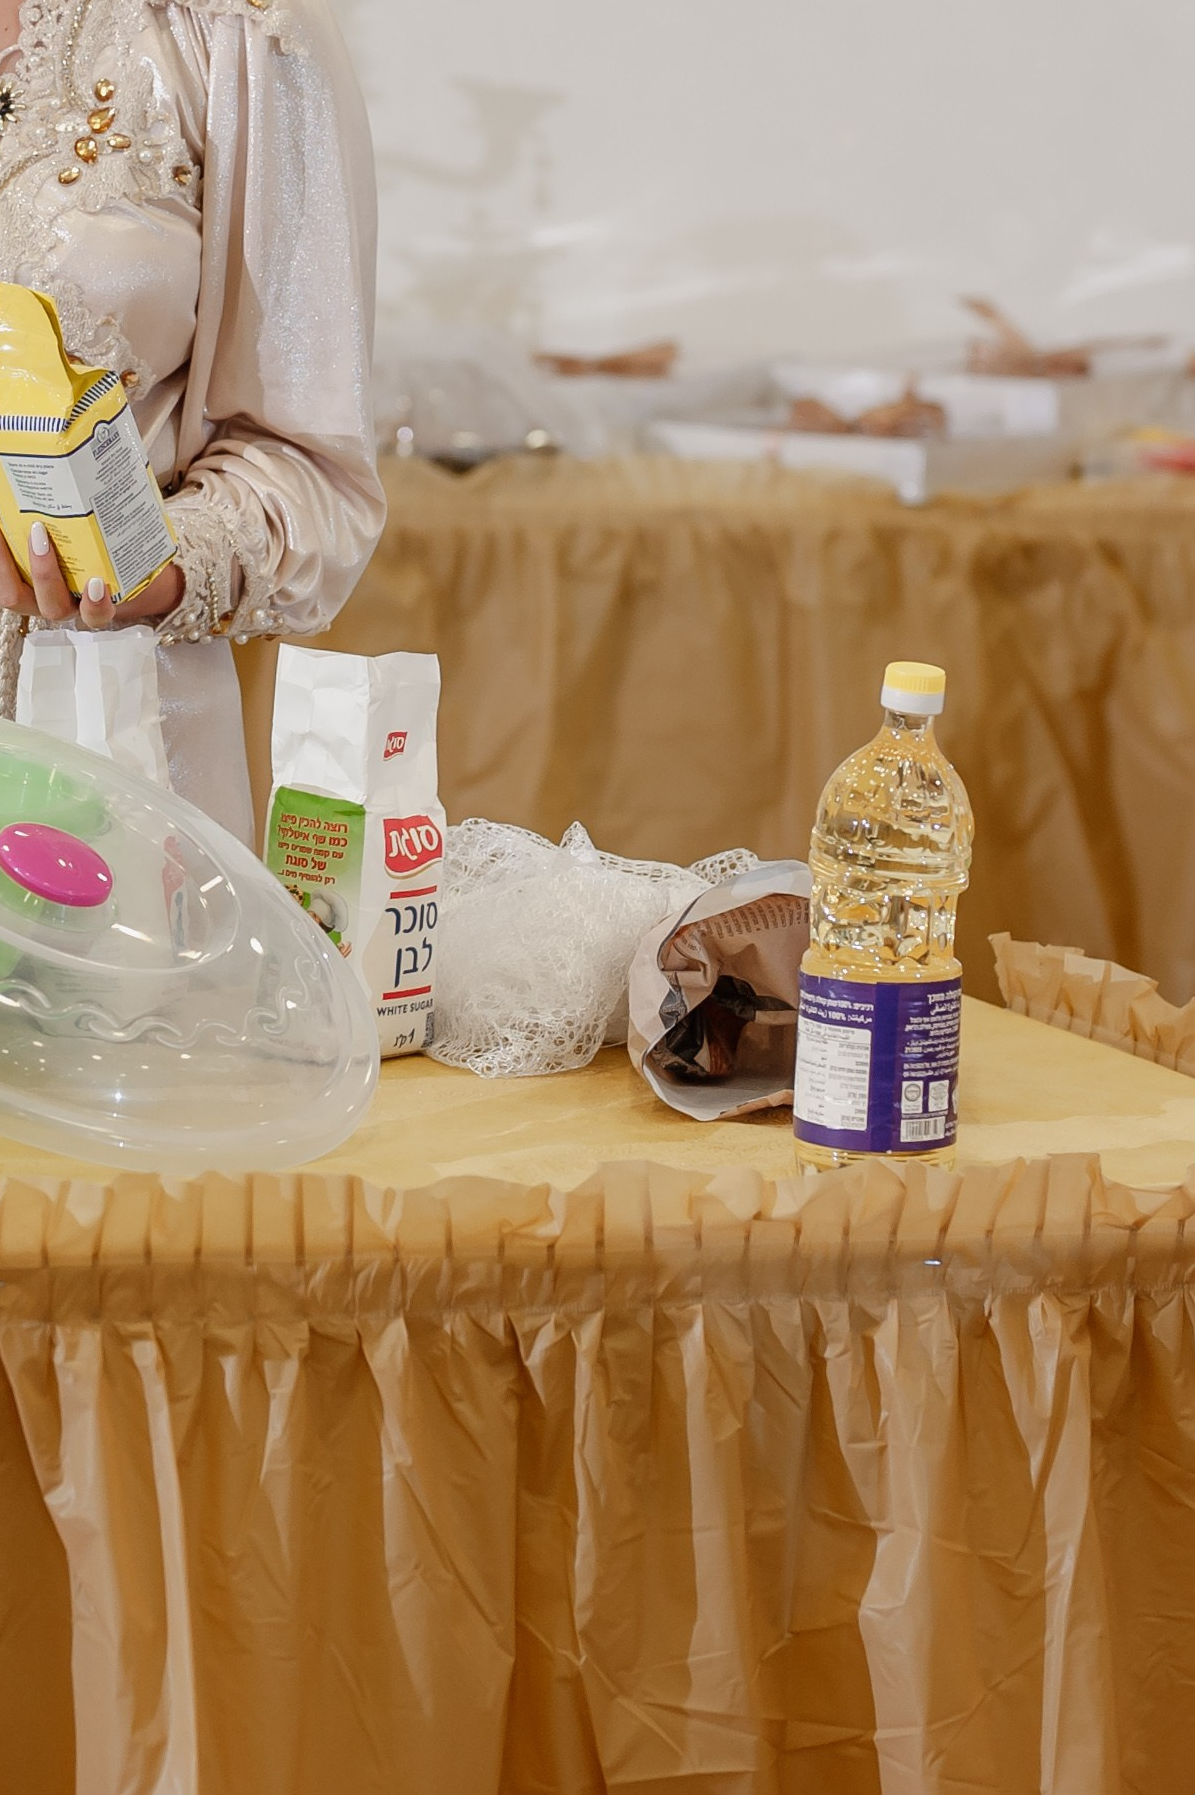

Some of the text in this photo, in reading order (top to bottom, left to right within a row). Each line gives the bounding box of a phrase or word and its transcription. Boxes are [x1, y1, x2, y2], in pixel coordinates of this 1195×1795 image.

[324, 821, 348, 833] רוצה
[329, 836, 348, 847] כמו
[389, 824, 439, 861] סוגת
[285, 854, 327, 871] של סוגת
[385, 902, 438, 935] סוכר
[394, 937, 433, 988] לבן
[376, 1004, 408, 1016] WHITE
[408, 1028, 415, 1044] 1
